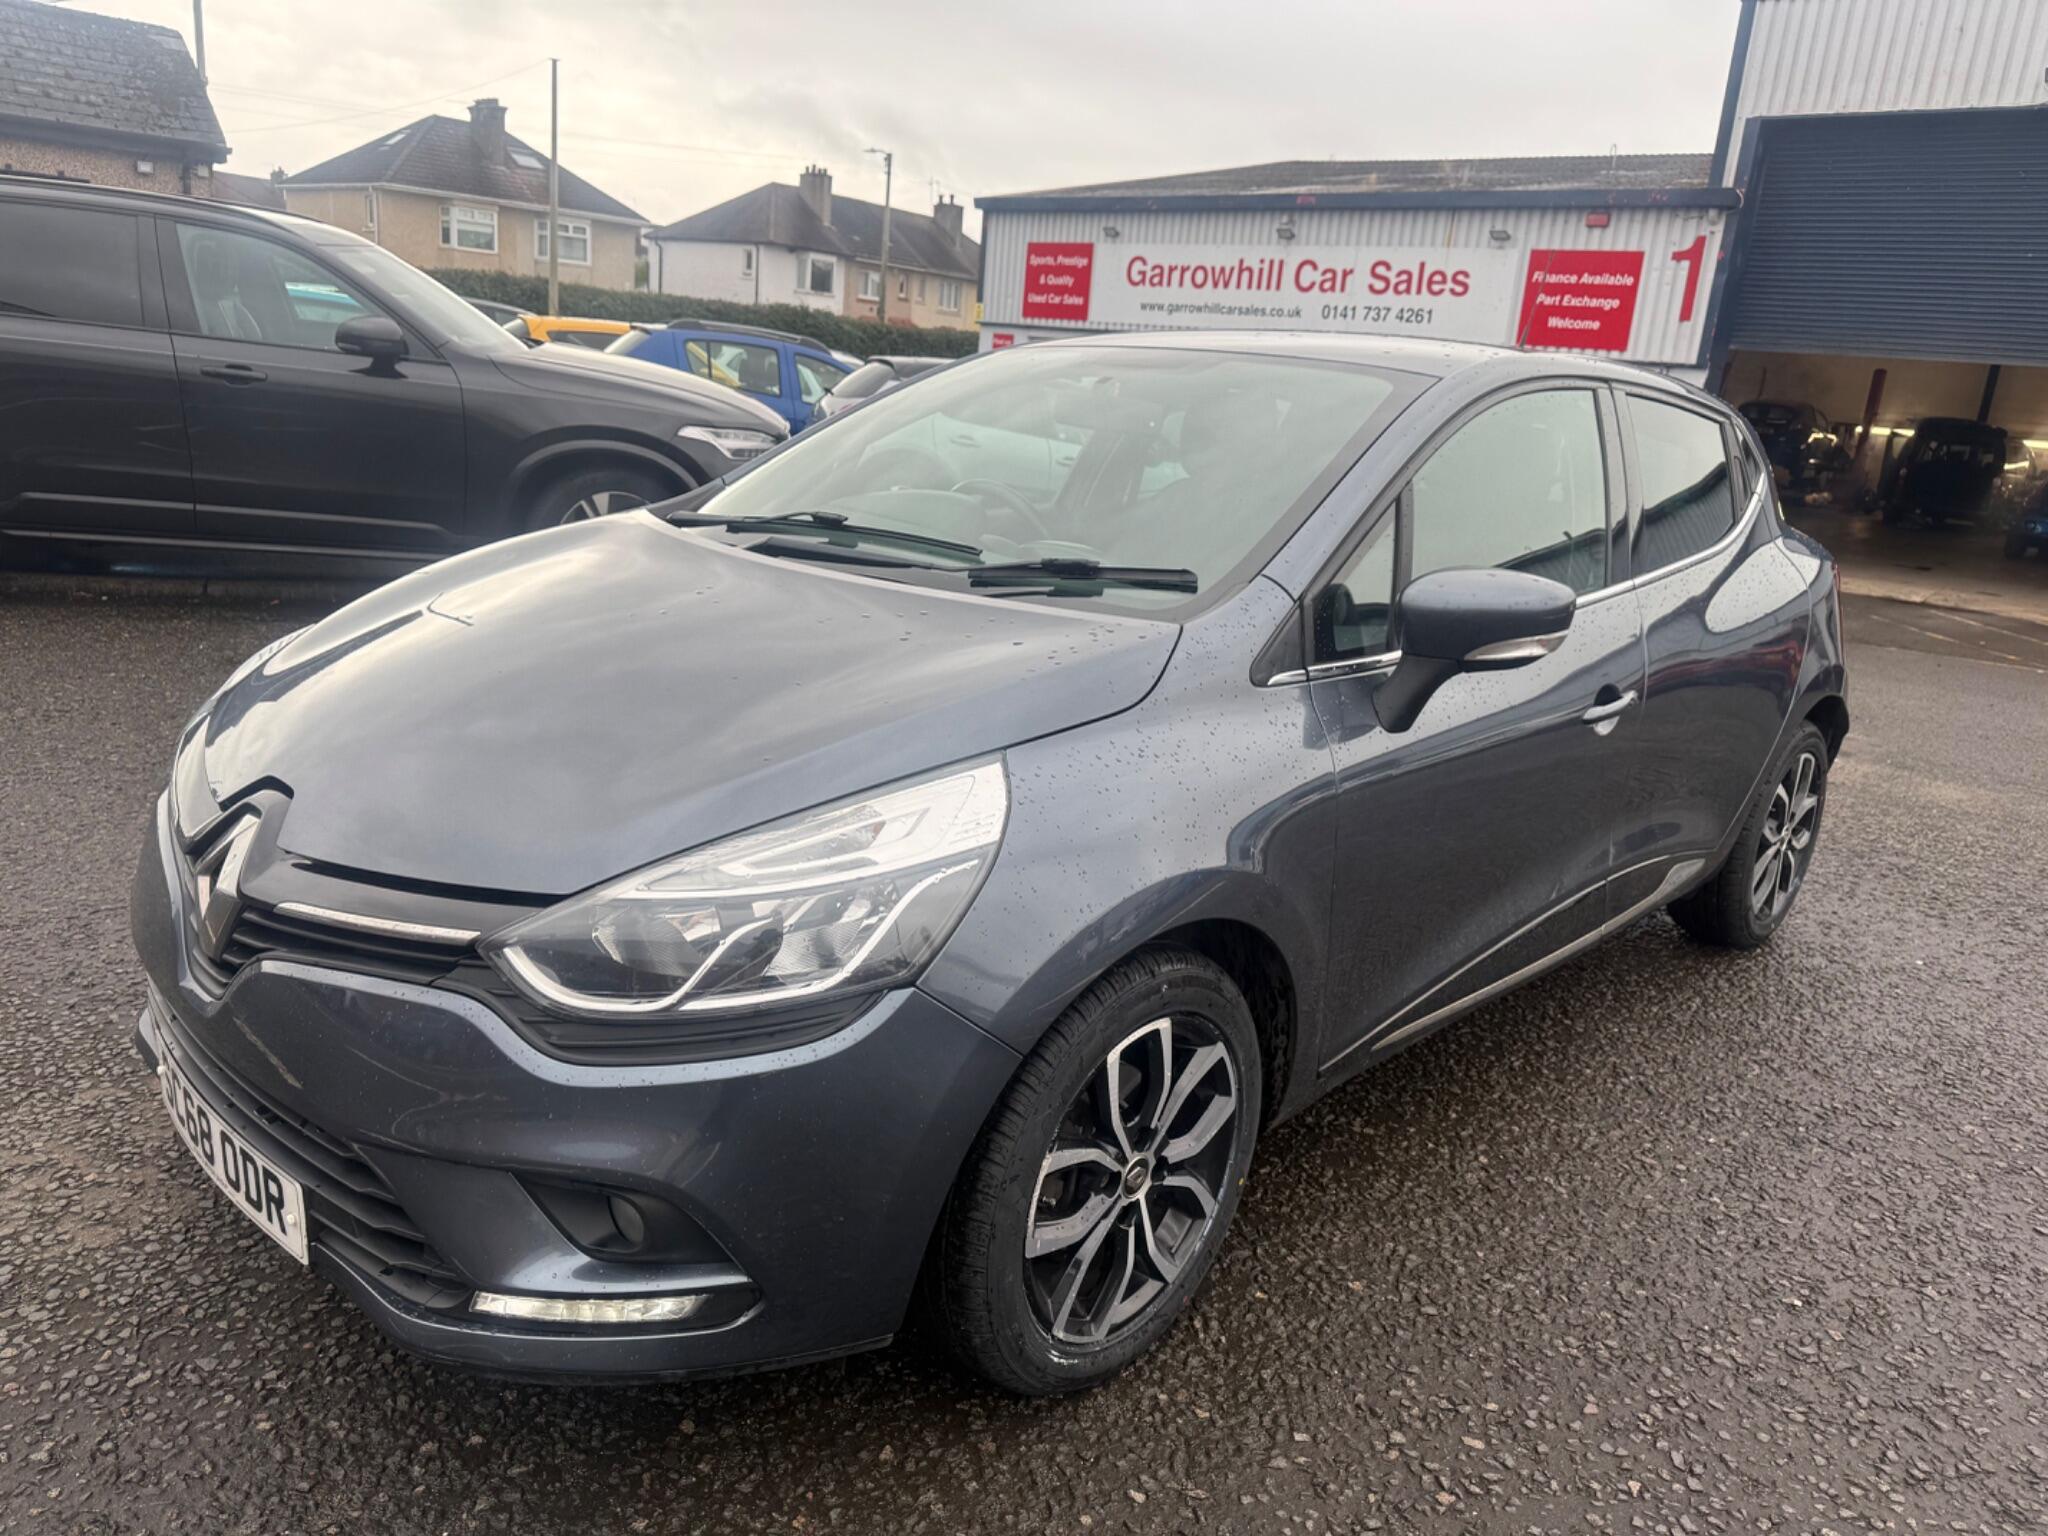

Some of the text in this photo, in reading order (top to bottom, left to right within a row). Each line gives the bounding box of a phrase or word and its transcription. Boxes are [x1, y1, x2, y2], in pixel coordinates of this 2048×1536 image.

[1056, 254, 1089, 269] Prestige
[1047, 273, 1075, 287] Quality
[1126, 255, 1471, 297] Garrowhill Car Sales
[1531, 271, 1634, 286] Finance Available
[1671, 235, 1707, 323] 1
[1027, 292, 1084, 306] Used Car Sales
[1536, 293, 1620, 310] Part Exchange
[1140, 302, 1302, 318] www.garrowhillcarsales.co.uk
[1321, 304, 1433, 324] 0141 737 4261
[1547, 316, 1601, 331] Welcome
[220, 1129, 288, 1236] ODR
